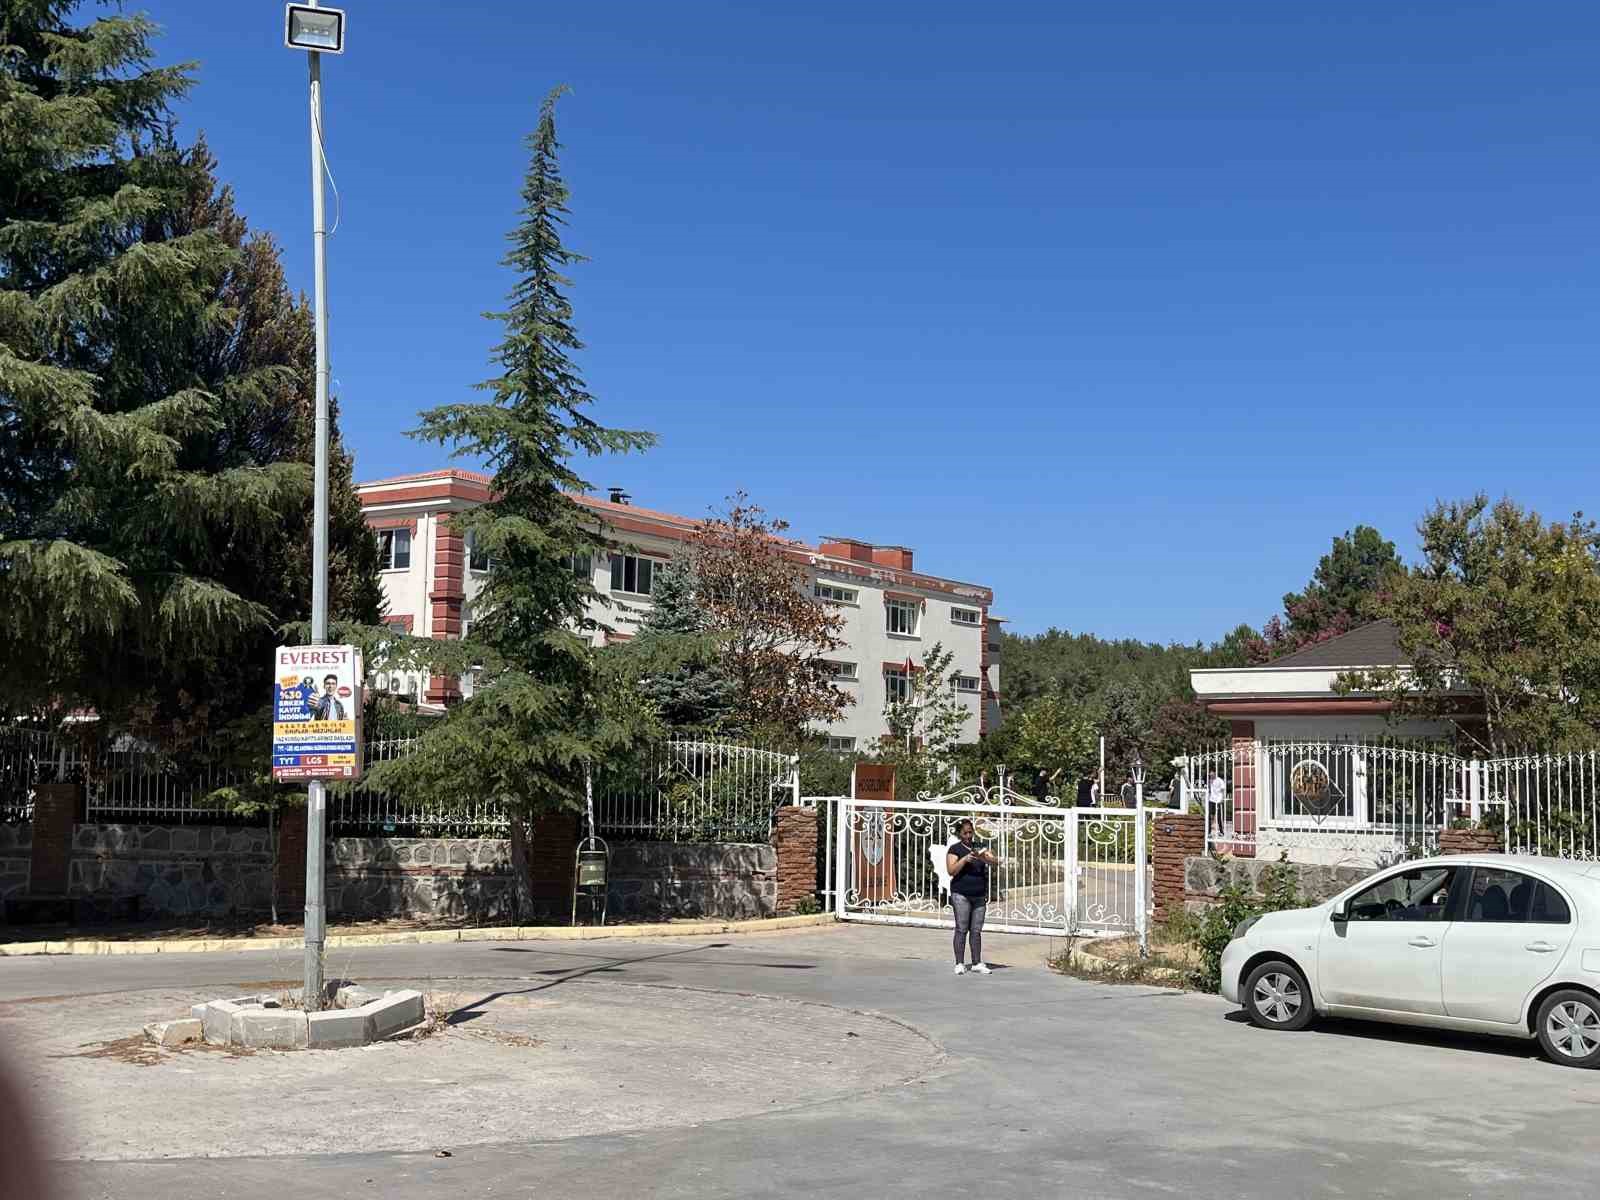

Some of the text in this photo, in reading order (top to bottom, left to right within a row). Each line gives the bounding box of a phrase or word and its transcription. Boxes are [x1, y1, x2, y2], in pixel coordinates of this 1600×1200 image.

[280, 651, 349, 664] EVEREST
[280, 691, 302, 700] %30
[280, 757, 322, 765] TYT LGS
